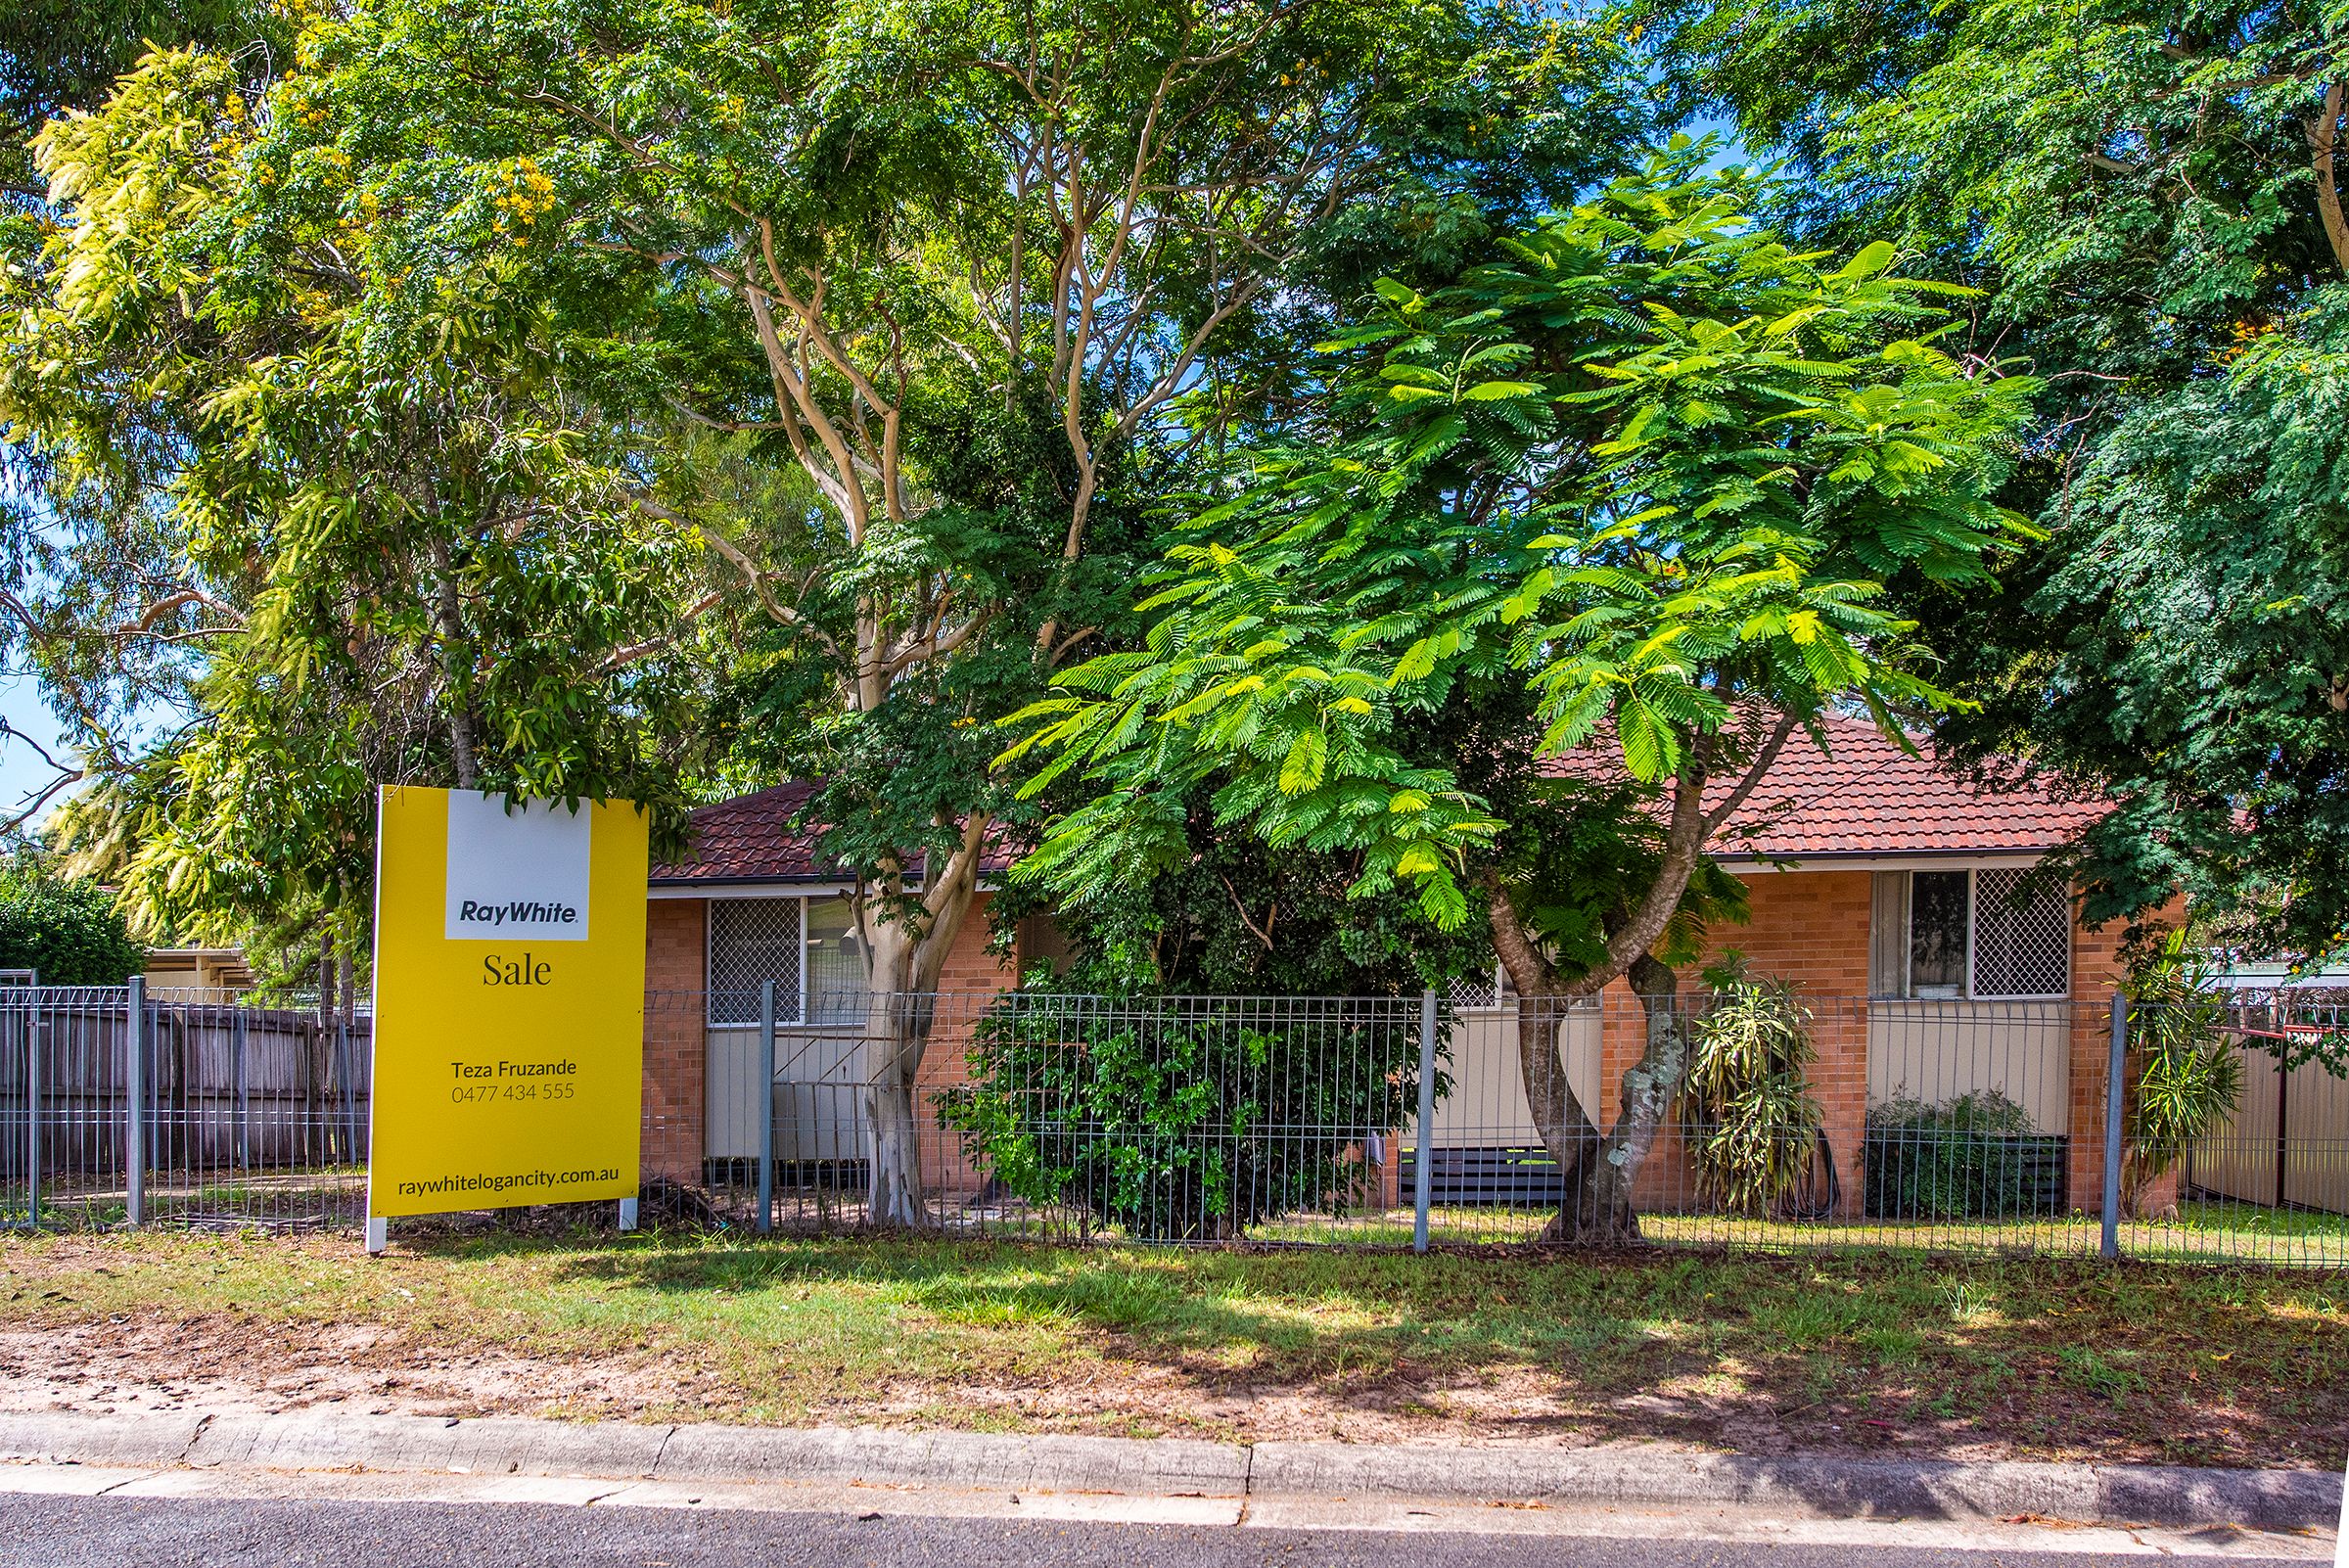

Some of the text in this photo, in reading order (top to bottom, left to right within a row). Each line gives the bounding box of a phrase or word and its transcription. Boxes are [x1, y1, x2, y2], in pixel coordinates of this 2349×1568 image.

[483, 952, 552, 987] Sale
[450, 1058, 577, 1079] Teza Fruzande
[451, 1083, 575, 1104] 0477 434 555
[397, 1167, 620, 1197] raywhitelogancity.com.au
